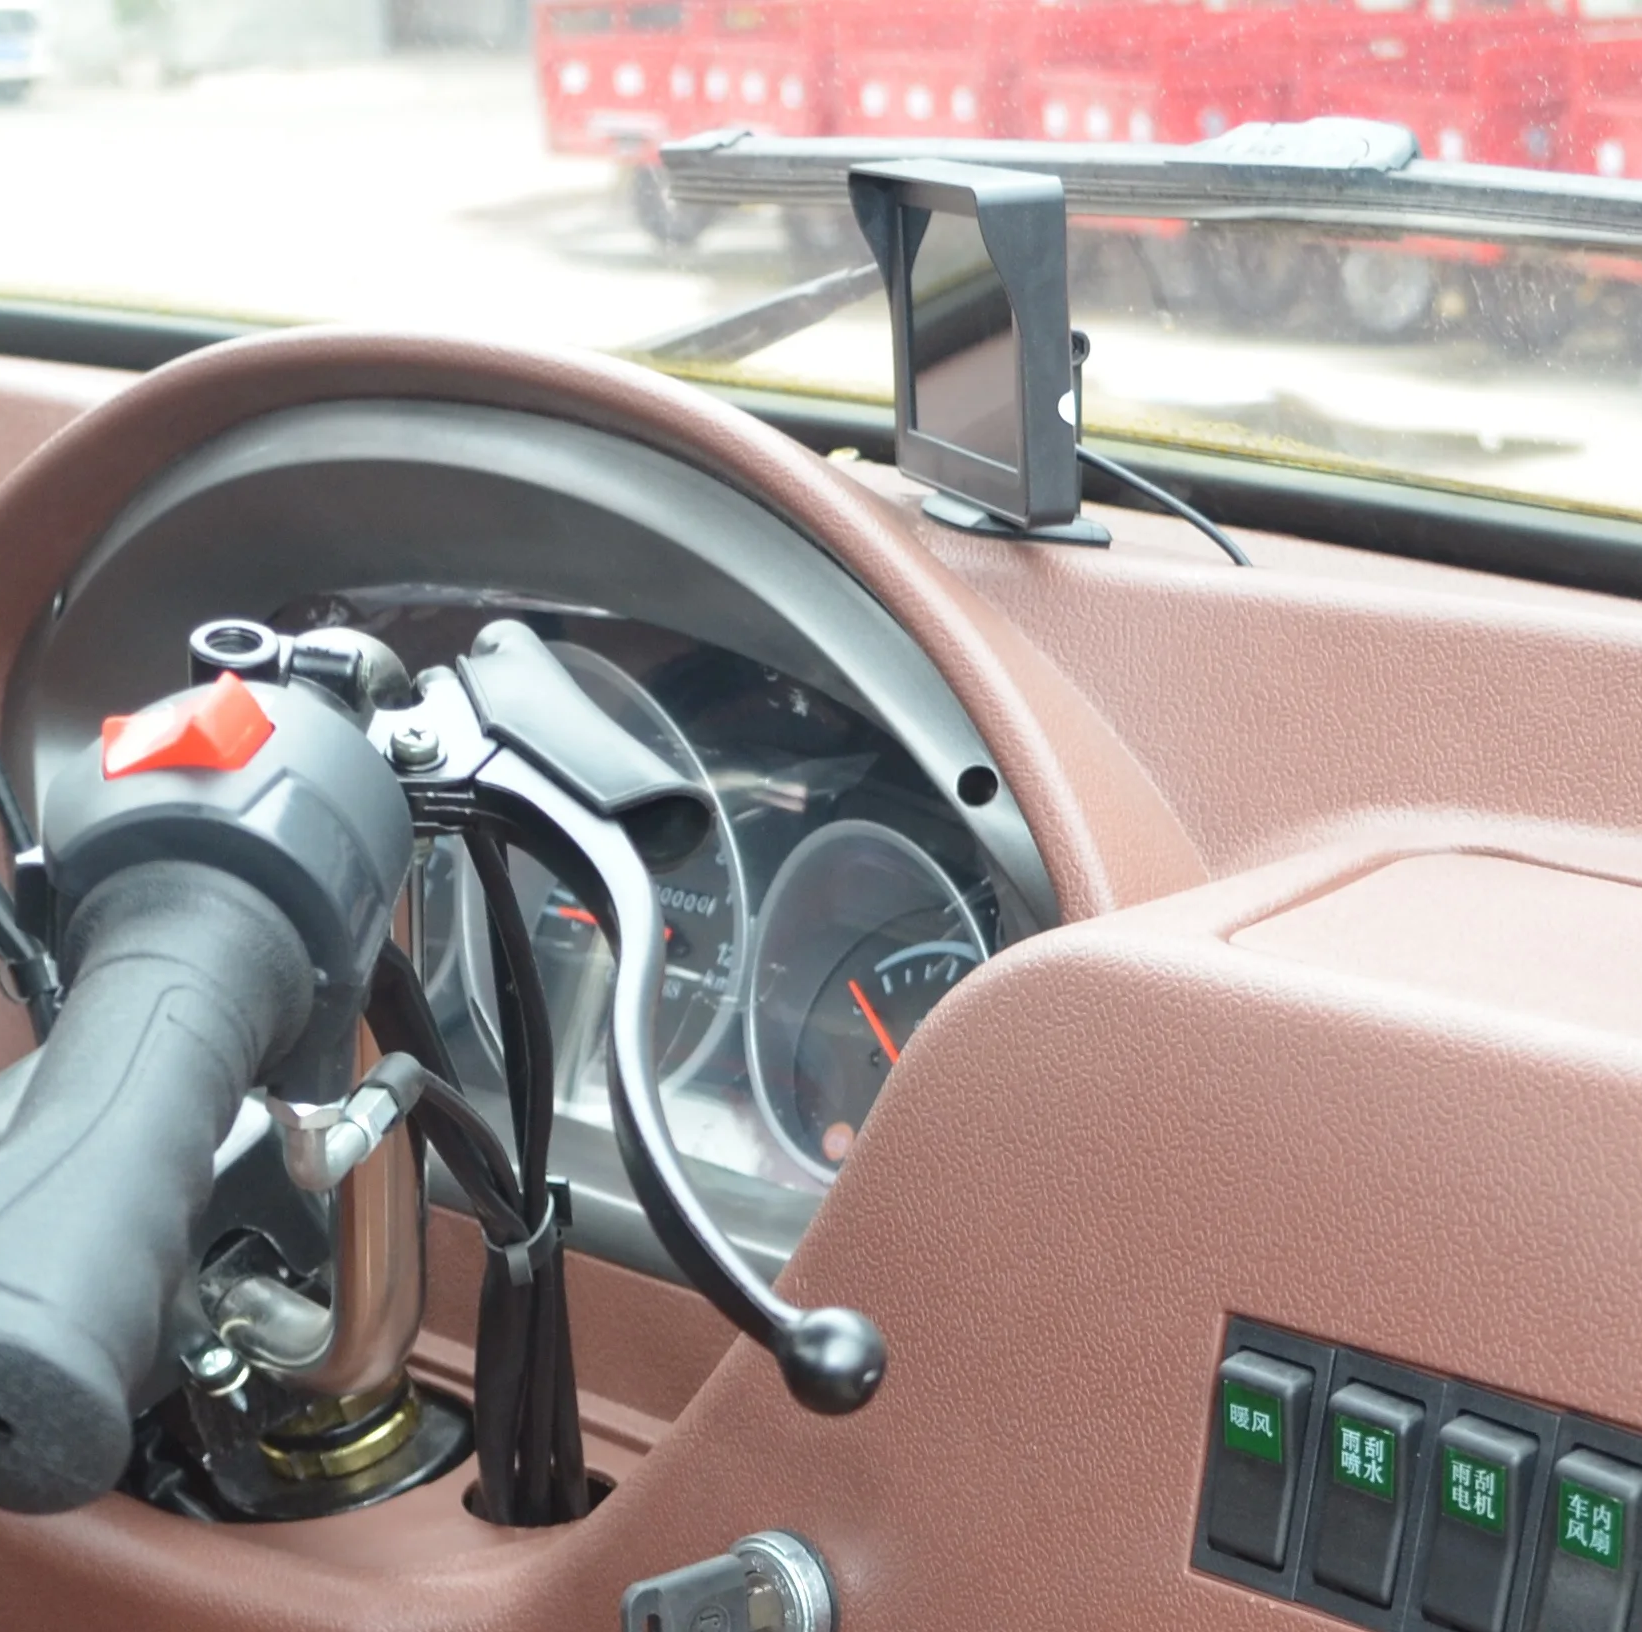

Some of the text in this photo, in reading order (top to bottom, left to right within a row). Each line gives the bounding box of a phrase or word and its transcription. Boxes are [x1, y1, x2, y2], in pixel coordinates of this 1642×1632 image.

[1229, 1403, 1273, 1438] 暖风
[1341, 1427, 1385, 1463] 雨刮
[1340, 1451, 1385, 1484] 喷水
[1450, 1460, 1495, 1496] 雨刮
[1450, 1486, 1495, 1520] 电机
[1567, 1493, 1612, 1531] 车内
[1565, 1519, 1612, 1555] 风扇
